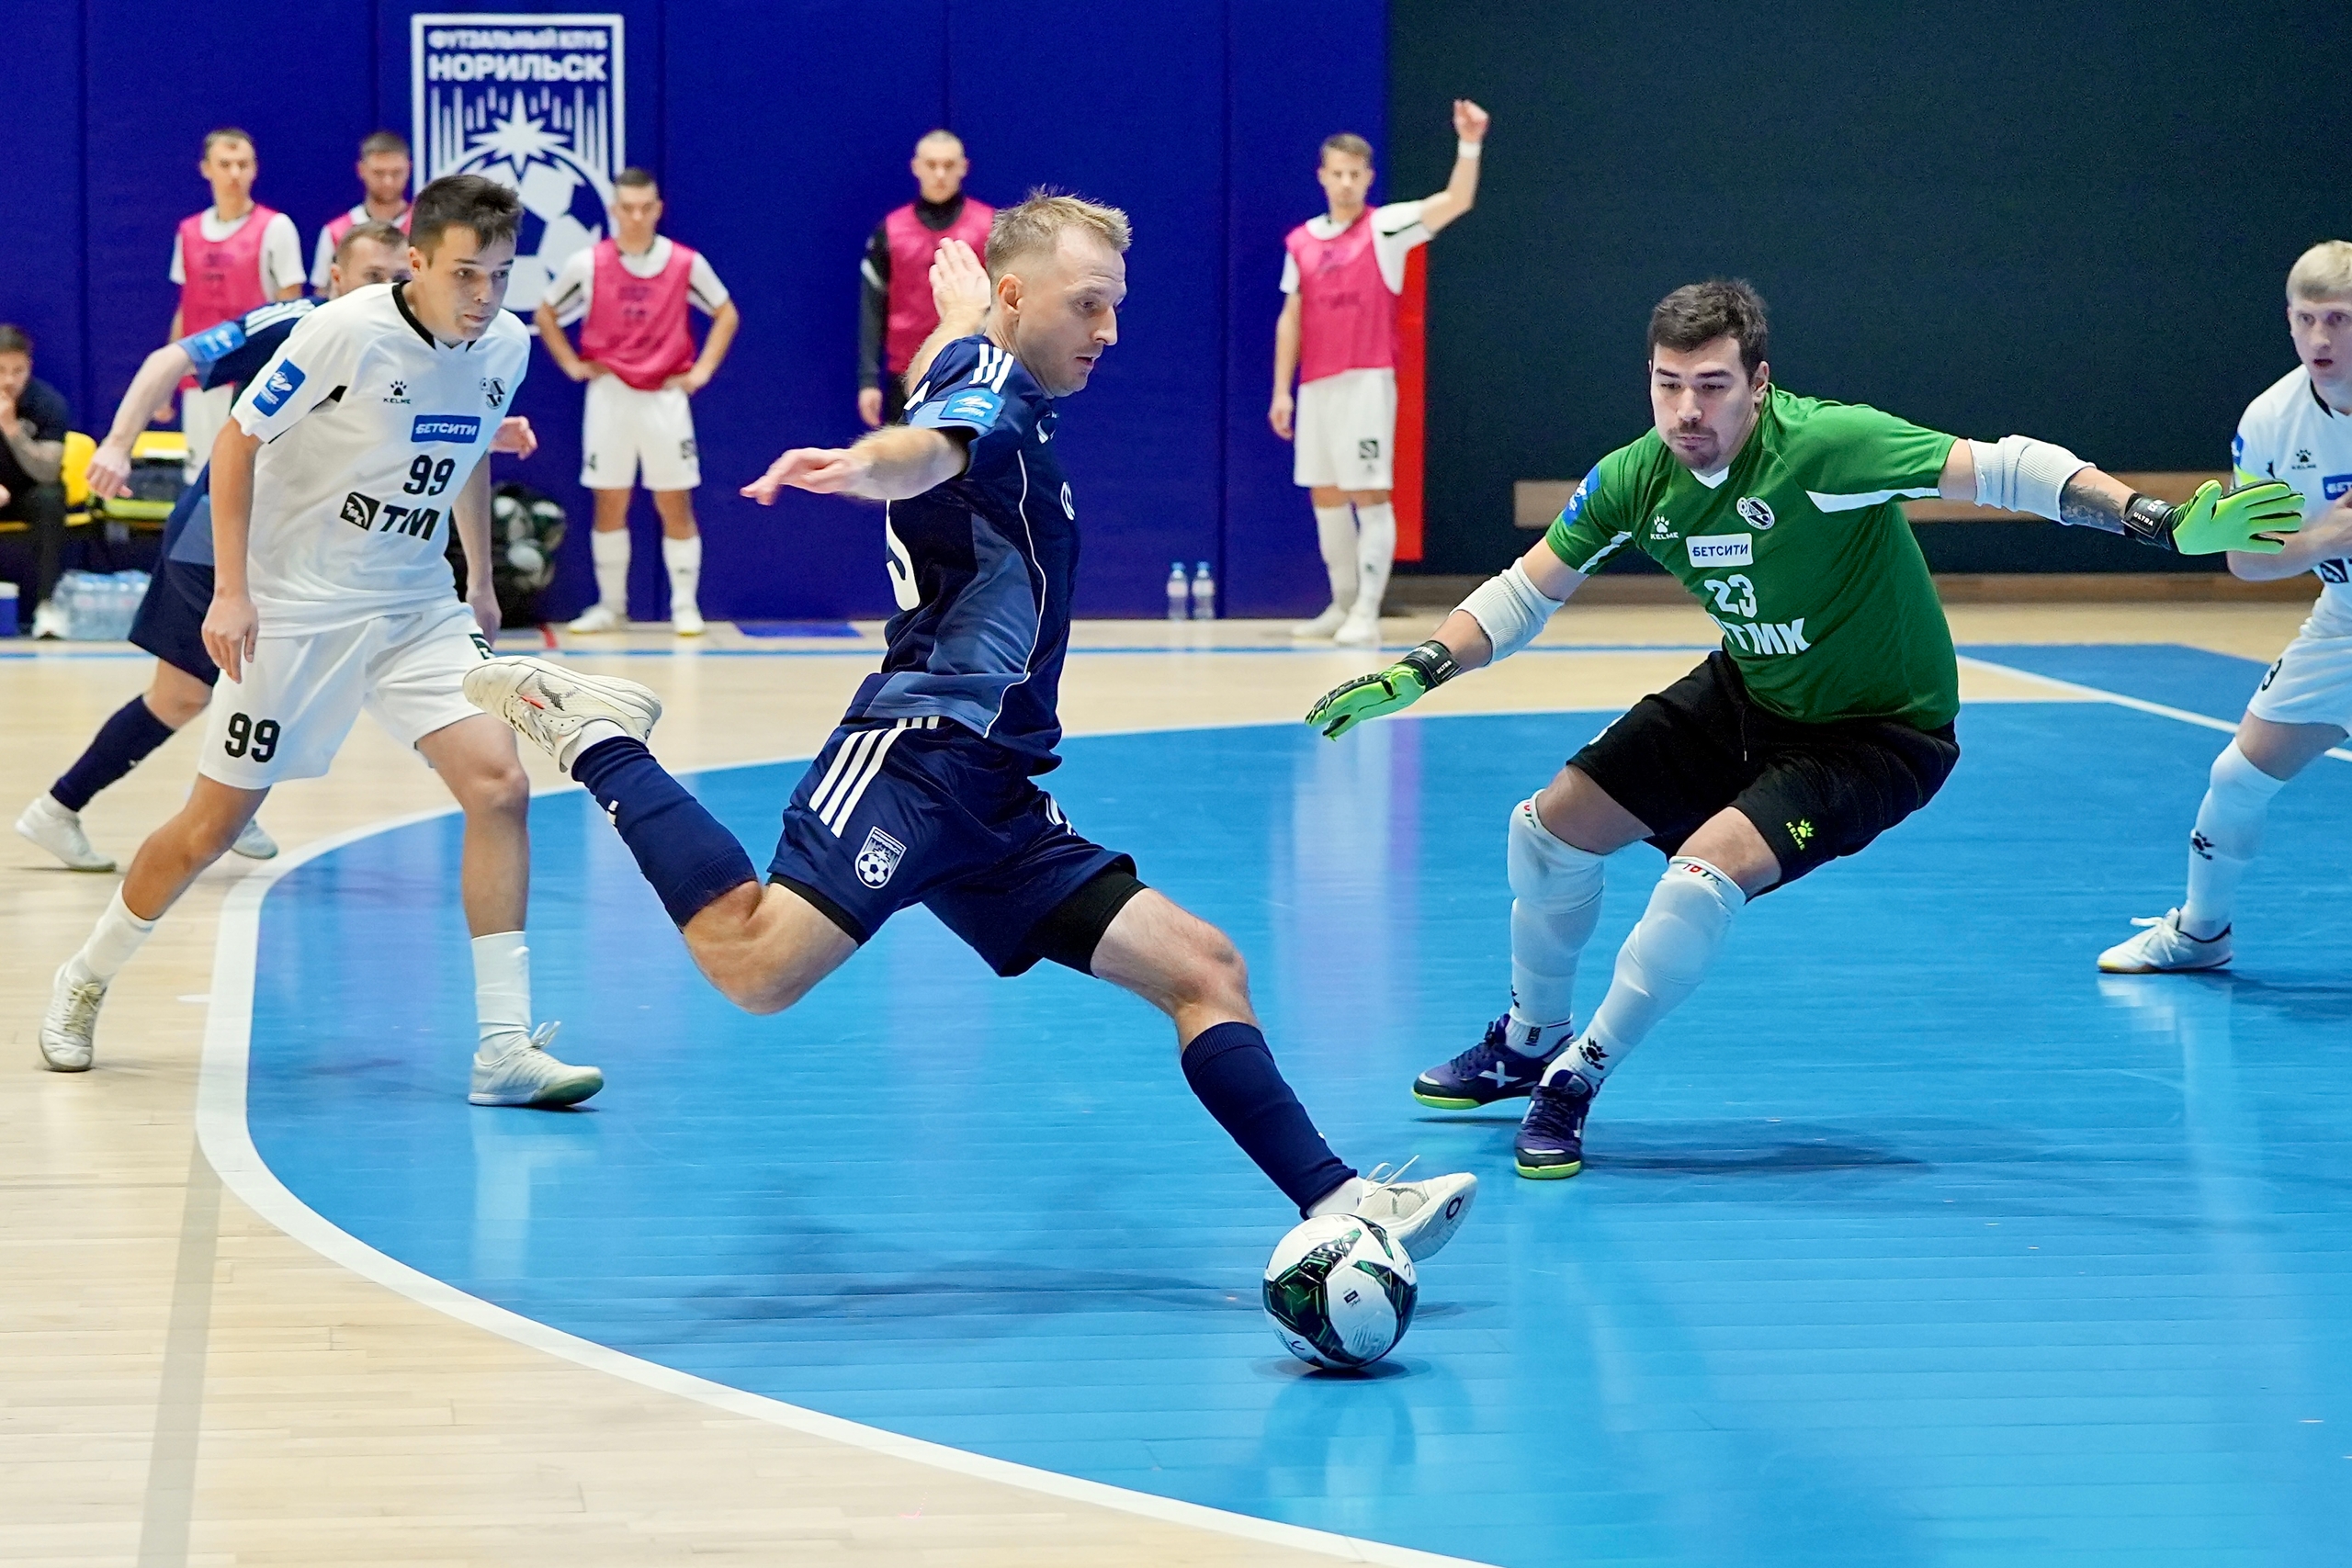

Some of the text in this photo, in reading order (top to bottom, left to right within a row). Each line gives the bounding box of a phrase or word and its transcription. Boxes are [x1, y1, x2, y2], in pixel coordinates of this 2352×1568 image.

[427, 53, 607, 82] НОРИЛЬСК
[415, 423, 478, 435] БЕТСИТИ
[402, 455, 456, 497] 99
[2132, 511, 2154, 526] ULTRA
[1650, 532, 1679, 540] KELME
[1692, 544, 1748, 557] БЕТСИТИ
[1703, 573, 1758, 618] 23
[224, 712, 281, 763] 99
[1785, 821, 1805, 851] KELME
